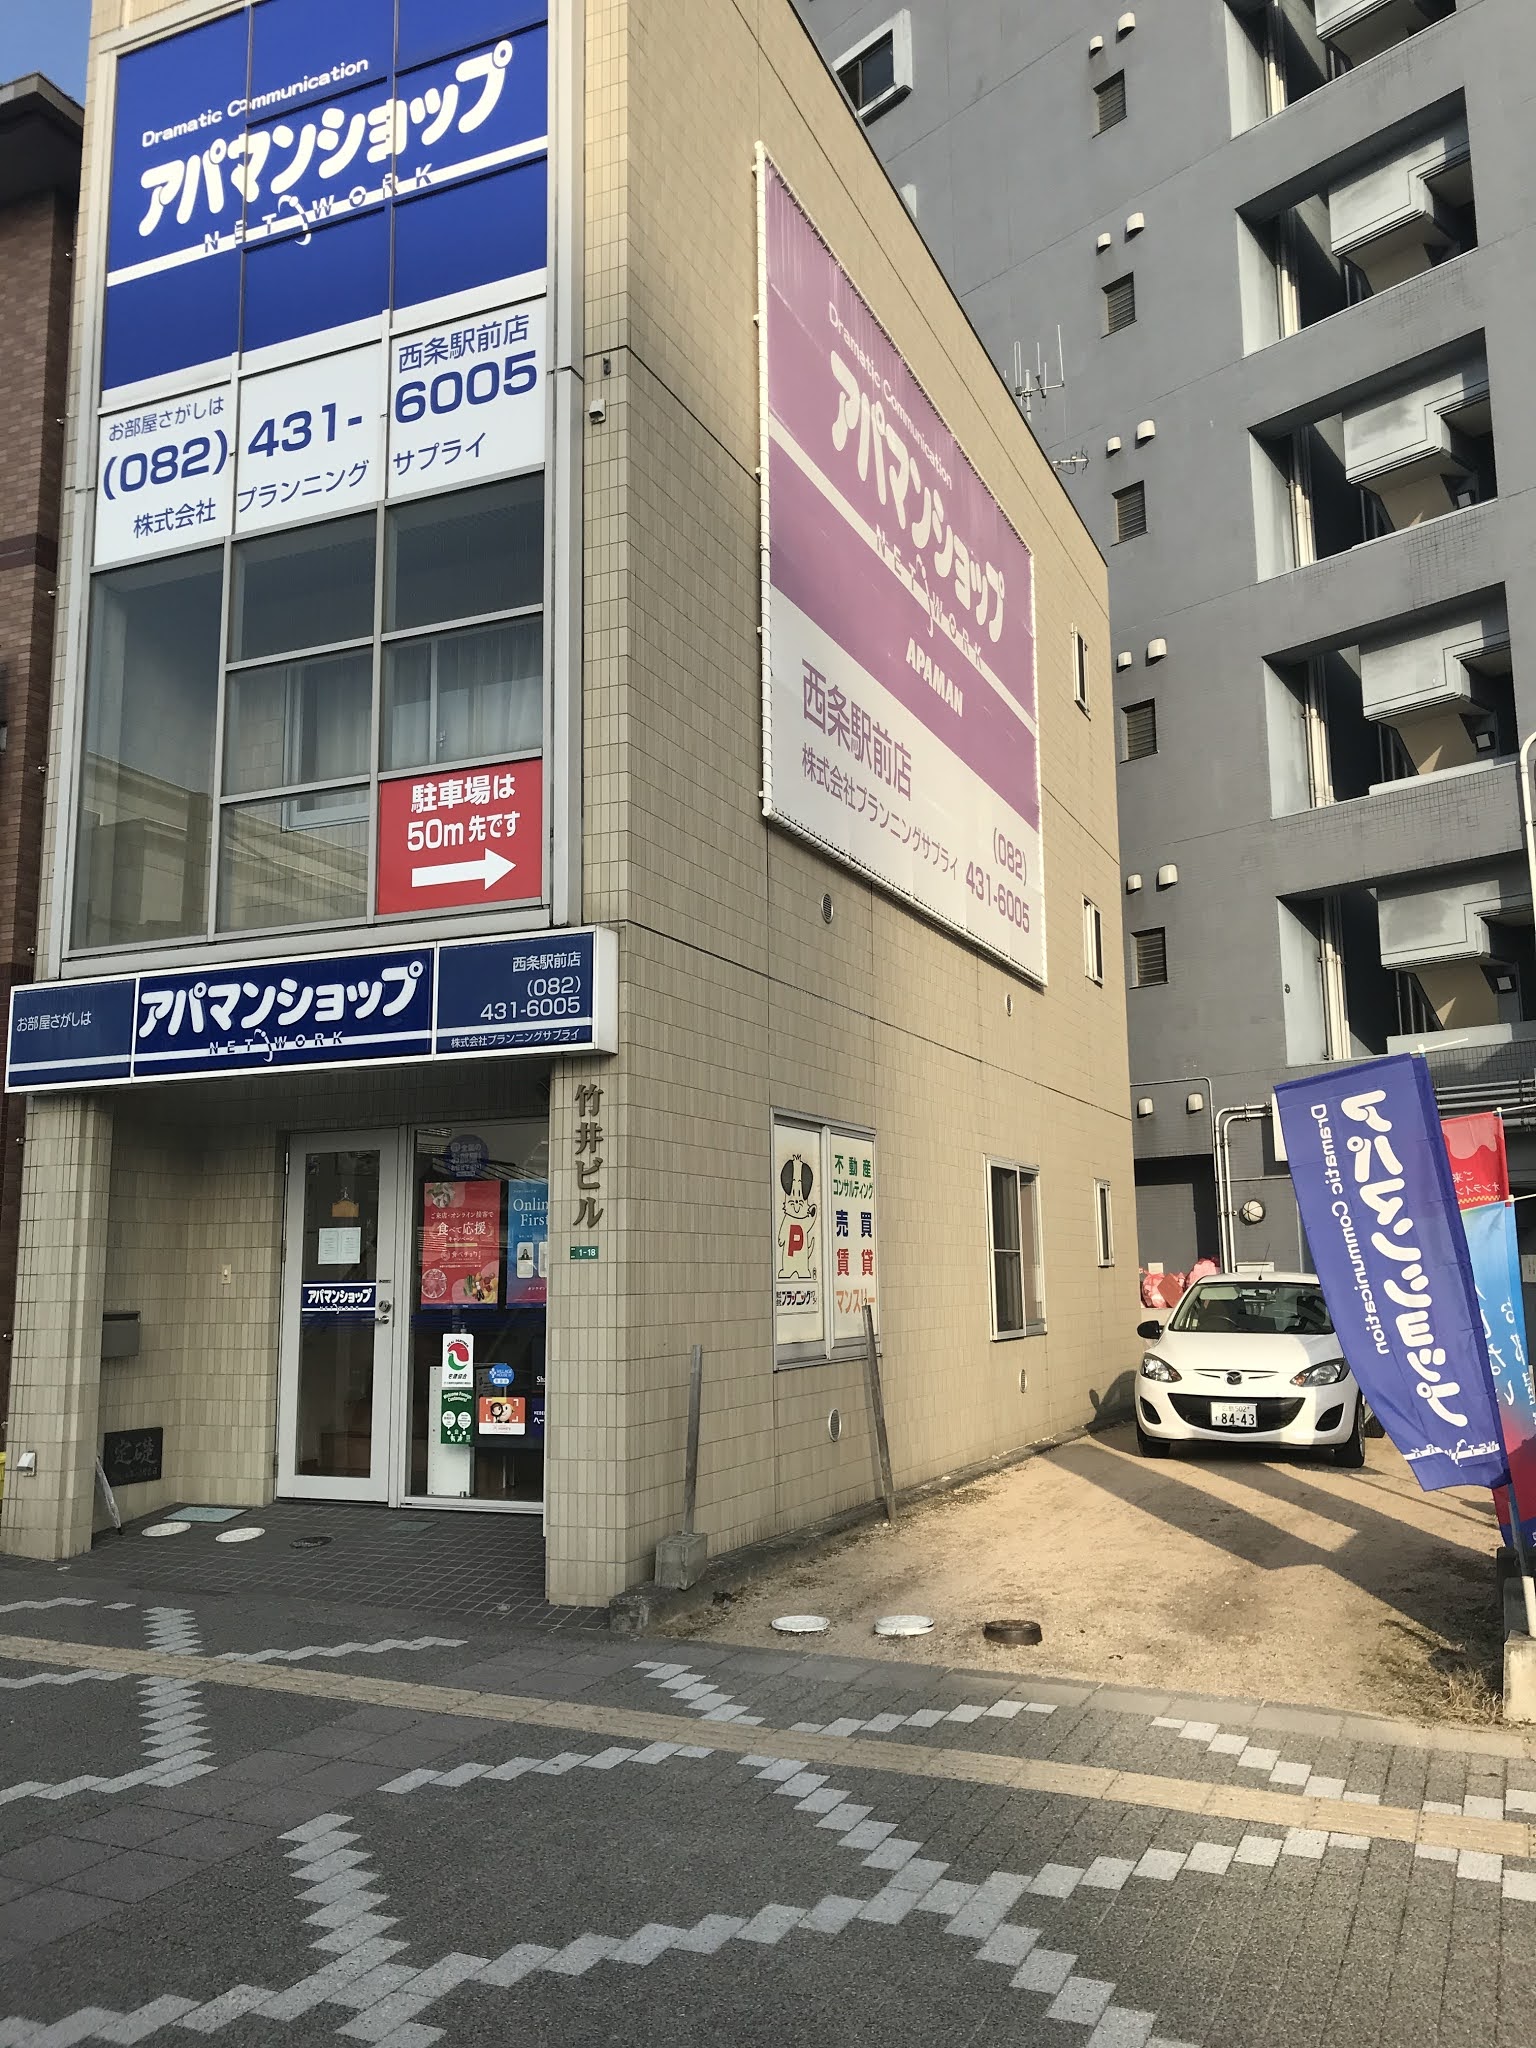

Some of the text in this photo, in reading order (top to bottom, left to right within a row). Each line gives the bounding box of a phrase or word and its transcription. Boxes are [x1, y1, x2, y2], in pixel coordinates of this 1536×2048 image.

[142, 58, 369, 148] Dramatic Communication
[138, 40, 514, 237] アパマンショップ
[398, 314, 530, 373] 西条駅前店
[108, 395, 224, 442] お部屋さがしは
[829, 301, 952, 491] Dramatic Communication
[103, 428, 228, 500] (082)
[395, 349, 538, 424] 6005
[133, 432, 487, 539] 株式会社 プランニング サプライ
[831, 350, 1005, 643] アパマンショップ
[906, 637, 963, 718] APAMAN
[801, 658, 912, 802] 西条駅前店
[411, 773, 516, 813] 駐車場は
[802, 742, 957, 880] 株式会社プランニングサプライ
[993, 827, 1027, 887] (082)
[965, 861, 1030, 933] 431-6005
[512, 951, 582, 973] 西条駅前店
[138, 960, 424, 1038] アパマンショップ
[480, 996, 580, 1021] 431-6005
[527, 975, 582, 997] (082)
[16, 1011, 92, 1032] お部屋さがしは
[450, 1028, 580, 1048] 株式会社プランニングサプライ
[573, 1084, 604, 1229] 竹井ビル
[834, 1154, 872, 1178] 不動産
[833, 1179, 873, 1200] コンサルティング
[437, 1221, 487, 1236] 食べて応援
[836, 1209, 872, 1238] 売買
[578, 1248, 596, 1258] 1-18
[837, 1248, 875, 1277] 賃貸
[307, 1288, 372, 1304] アパマンショップ
[1221, 1412, 1255, 1426] 84-43
